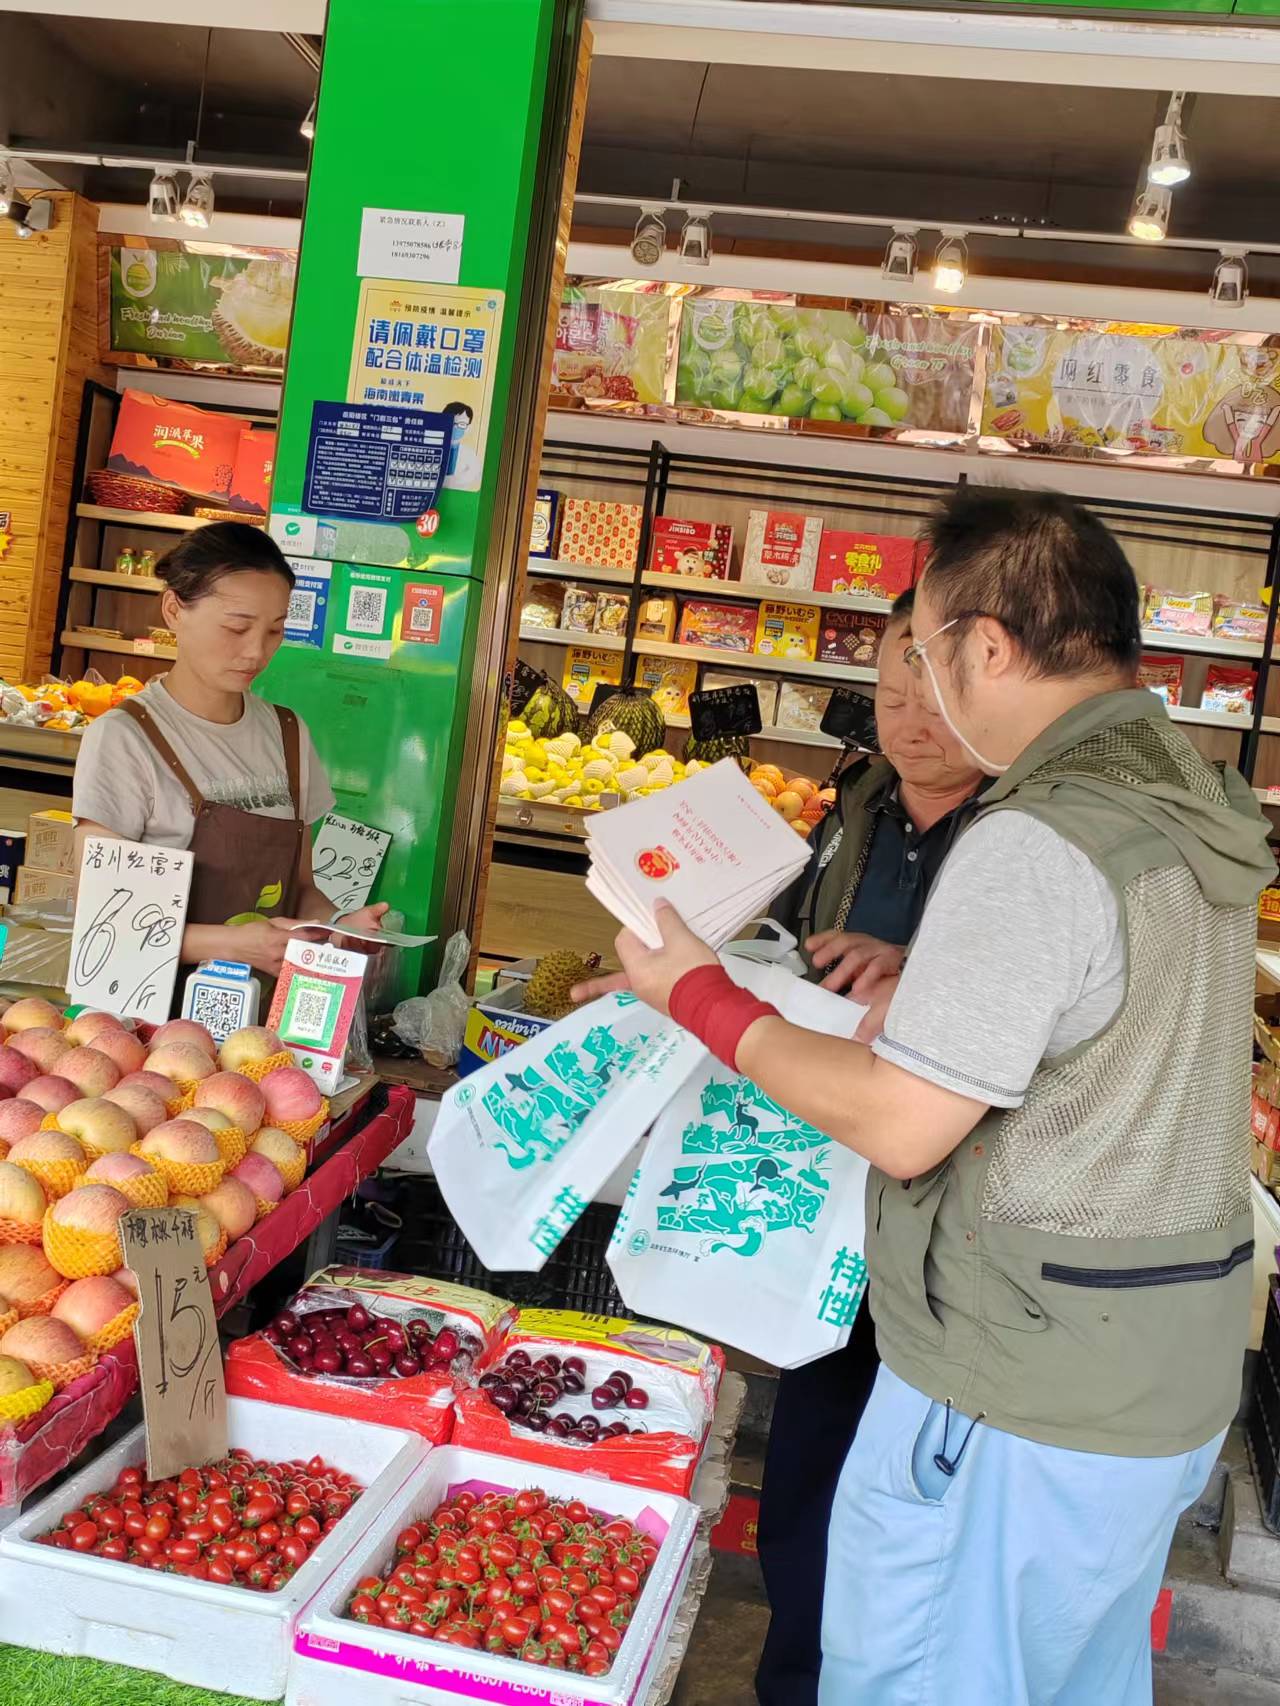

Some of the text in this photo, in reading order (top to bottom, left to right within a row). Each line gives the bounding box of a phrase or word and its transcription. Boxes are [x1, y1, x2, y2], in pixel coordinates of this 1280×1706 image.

[369, 319, 486, 354] 请佩戴口罩
[365, 347, 483, 379] 配合体温检测
[1060, 357, 1160, 390] 网红零食
[417, 514, 438, 533] 30
[85, 843, 185, 877] 洛川红富士
[318, 951, 350, 968] 中国银行
[493, 1018, 541, 1039] Grapes
